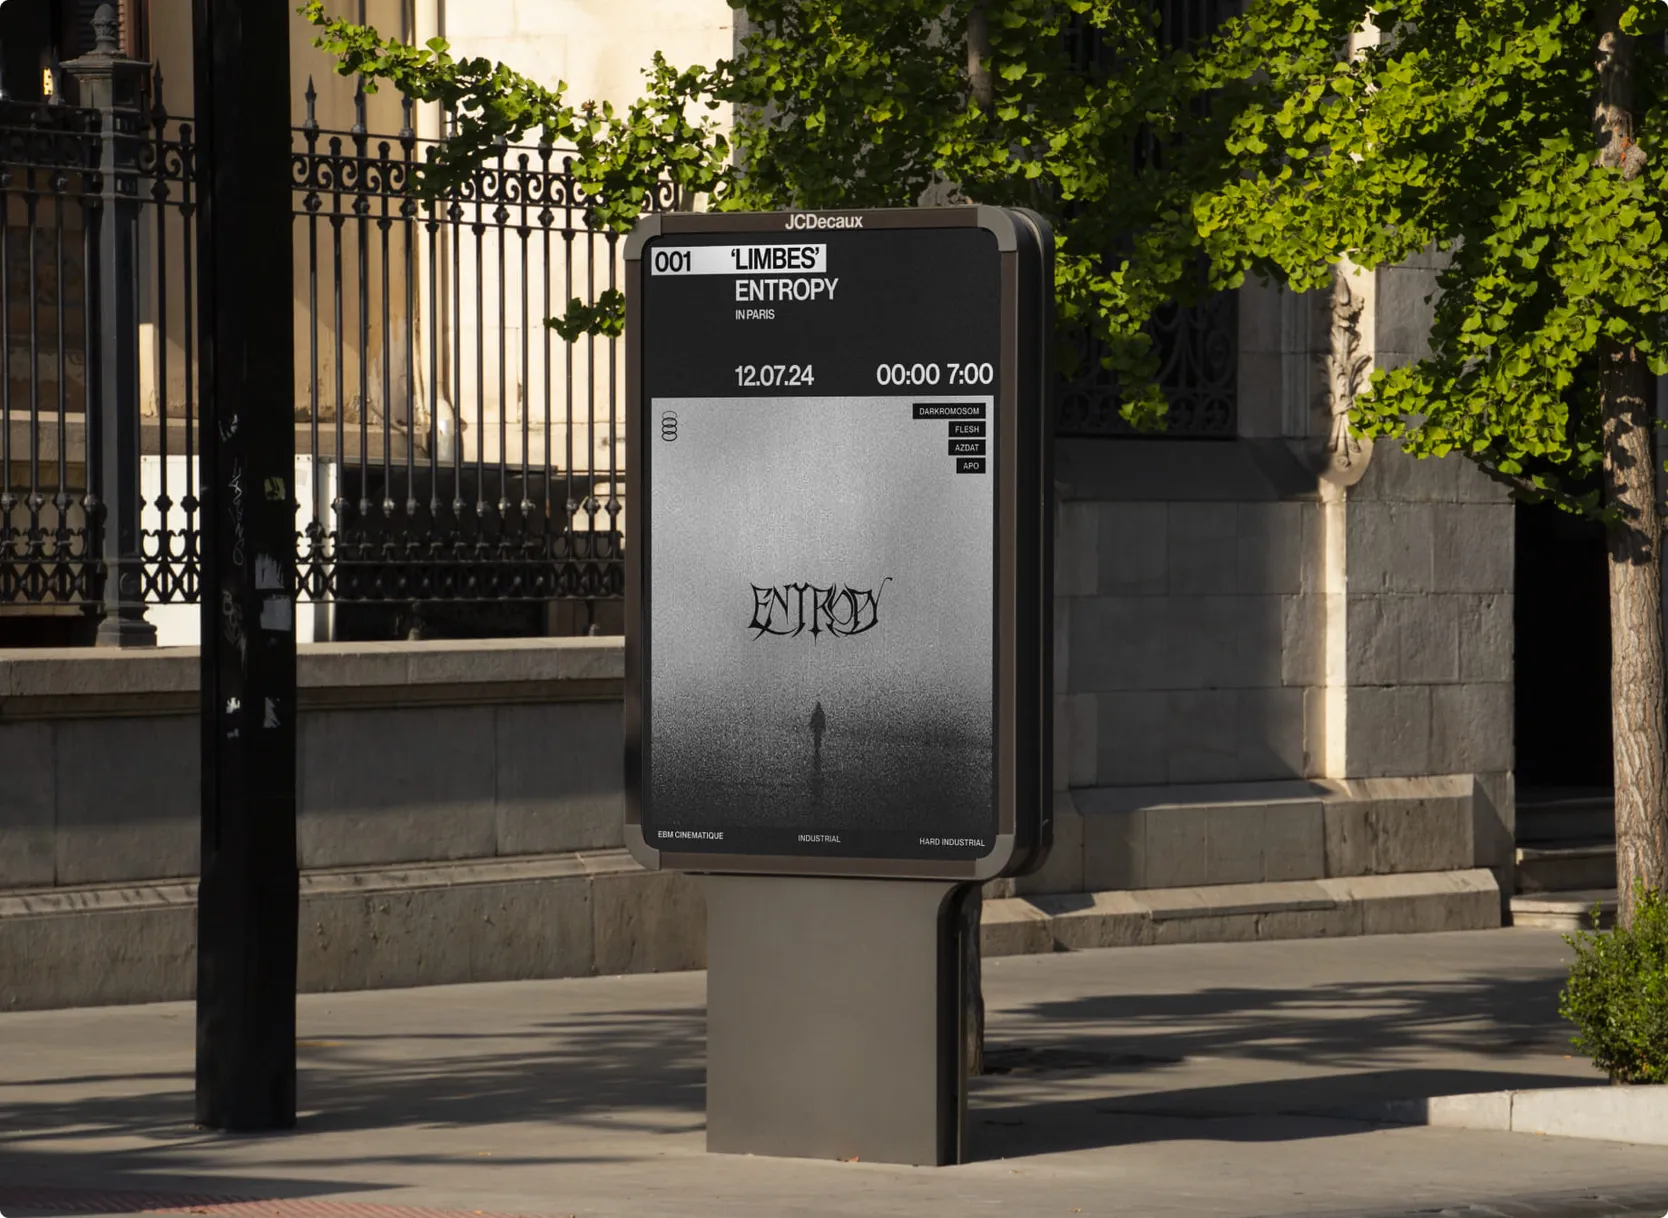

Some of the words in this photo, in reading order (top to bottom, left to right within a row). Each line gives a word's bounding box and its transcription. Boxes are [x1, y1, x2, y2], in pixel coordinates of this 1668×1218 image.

[785, 213, 864, 231] JCDecaux
[654, 250, 692, 273] 001
[730, 246, 820, 270] ‘LIMBES’
[735, 277, 839, 302] ENTROPY
[735, 309, 745, 320] IN
[746, 308, 775, 320] PARIS
[734, 364, 815, 387] 12.07.24
[876, 363, 940, 386] 00:00
[947, 362, 994, 385] 7:00
[919, 406, 980, 416] DARKROMOSOM
[955, 424, 980, 434] FLESH
[954, 442, 979, 452] AZDAT
[963, 461, 980, 471] APO
[657, 830, 674, 840] EBM
[674, 830, 724, 841] CINEMATIQUE
[797, 834, 841, 843] INDUSTRIAL
[919, 837, 940, 847] HARD
[941, 838, 986, 847] INDUSTRIAL
